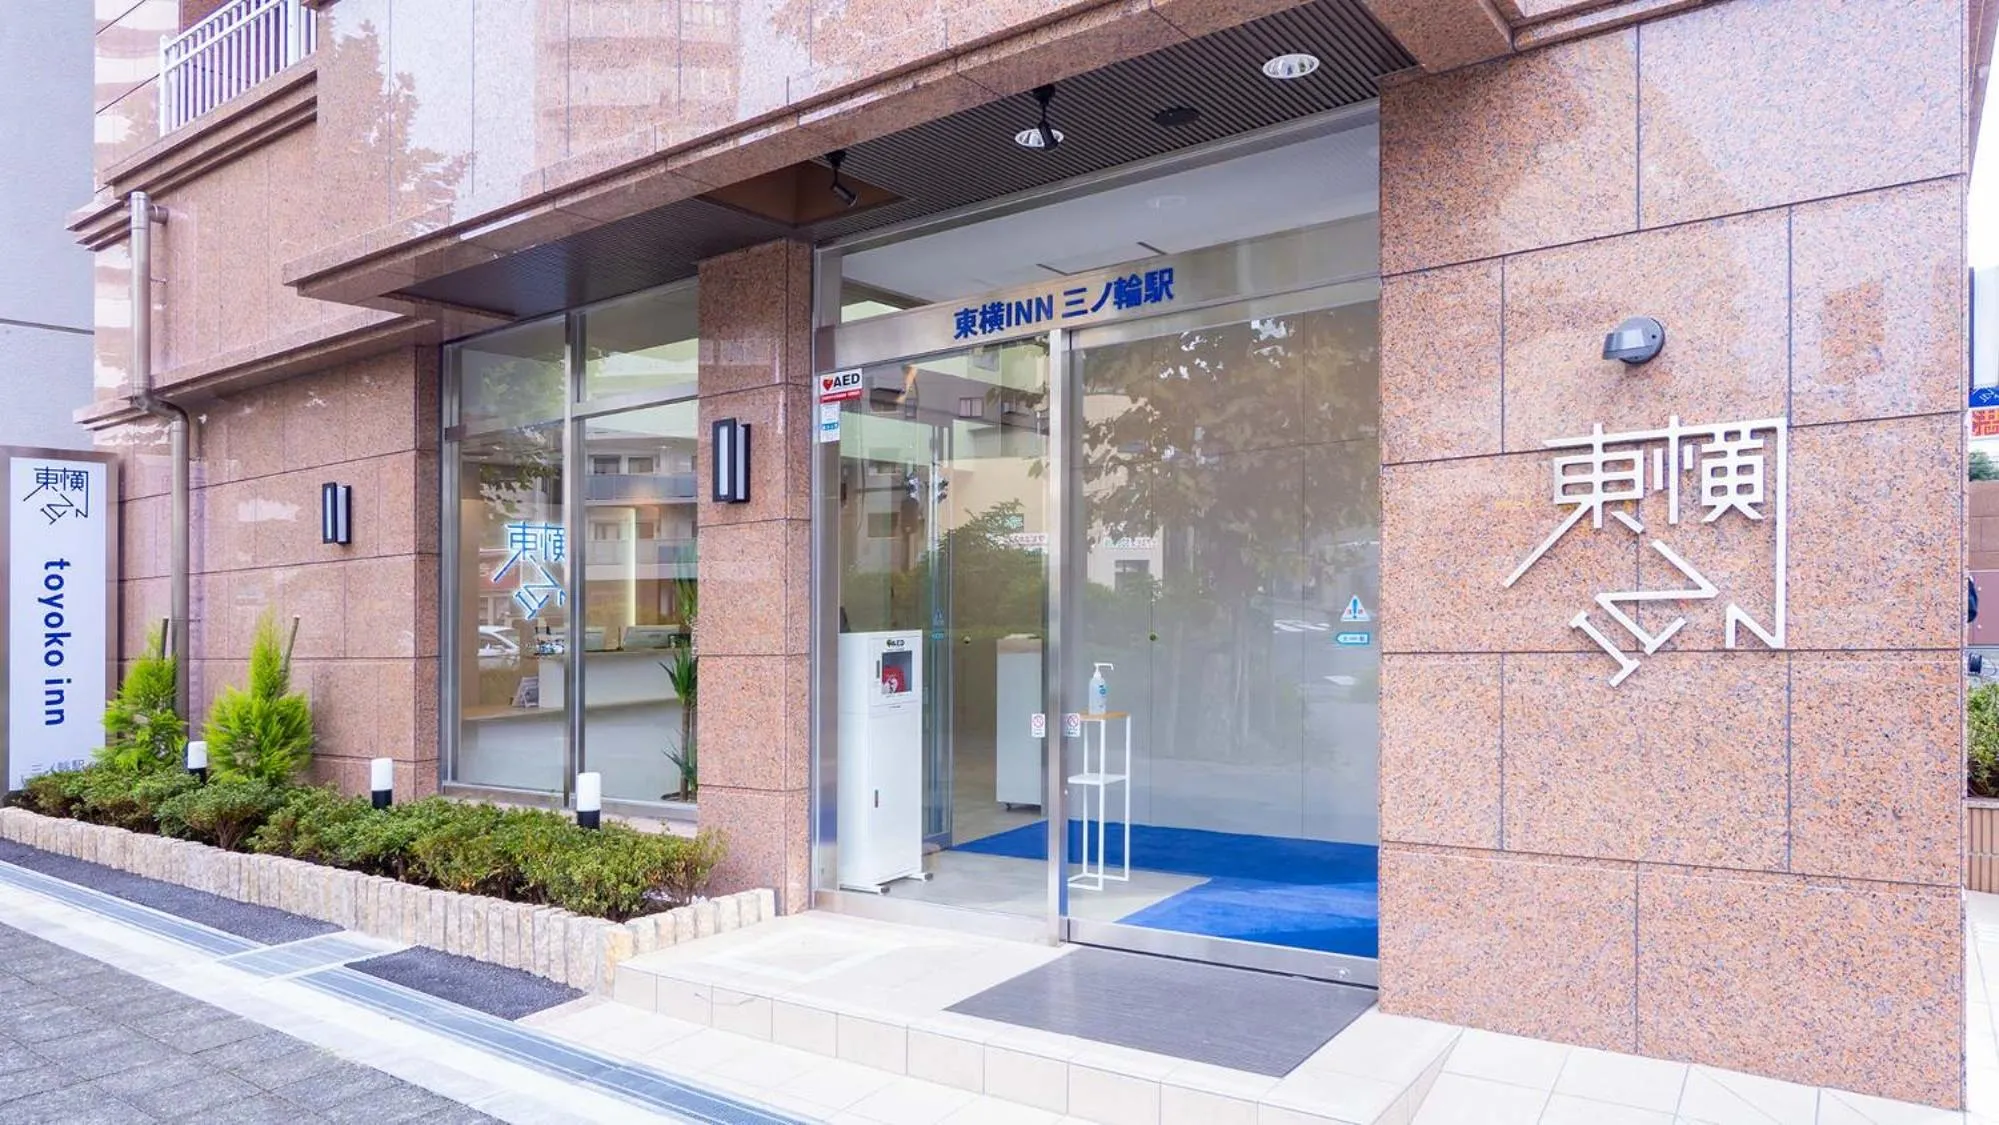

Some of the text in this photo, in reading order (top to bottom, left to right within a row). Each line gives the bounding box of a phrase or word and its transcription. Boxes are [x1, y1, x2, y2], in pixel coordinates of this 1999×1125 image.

[953, 267, 1174, 340] 東横INN 三ノ輪駅
[833, 372, 860, 388] AED
[37, 558, 72, 726] toyoko inn
